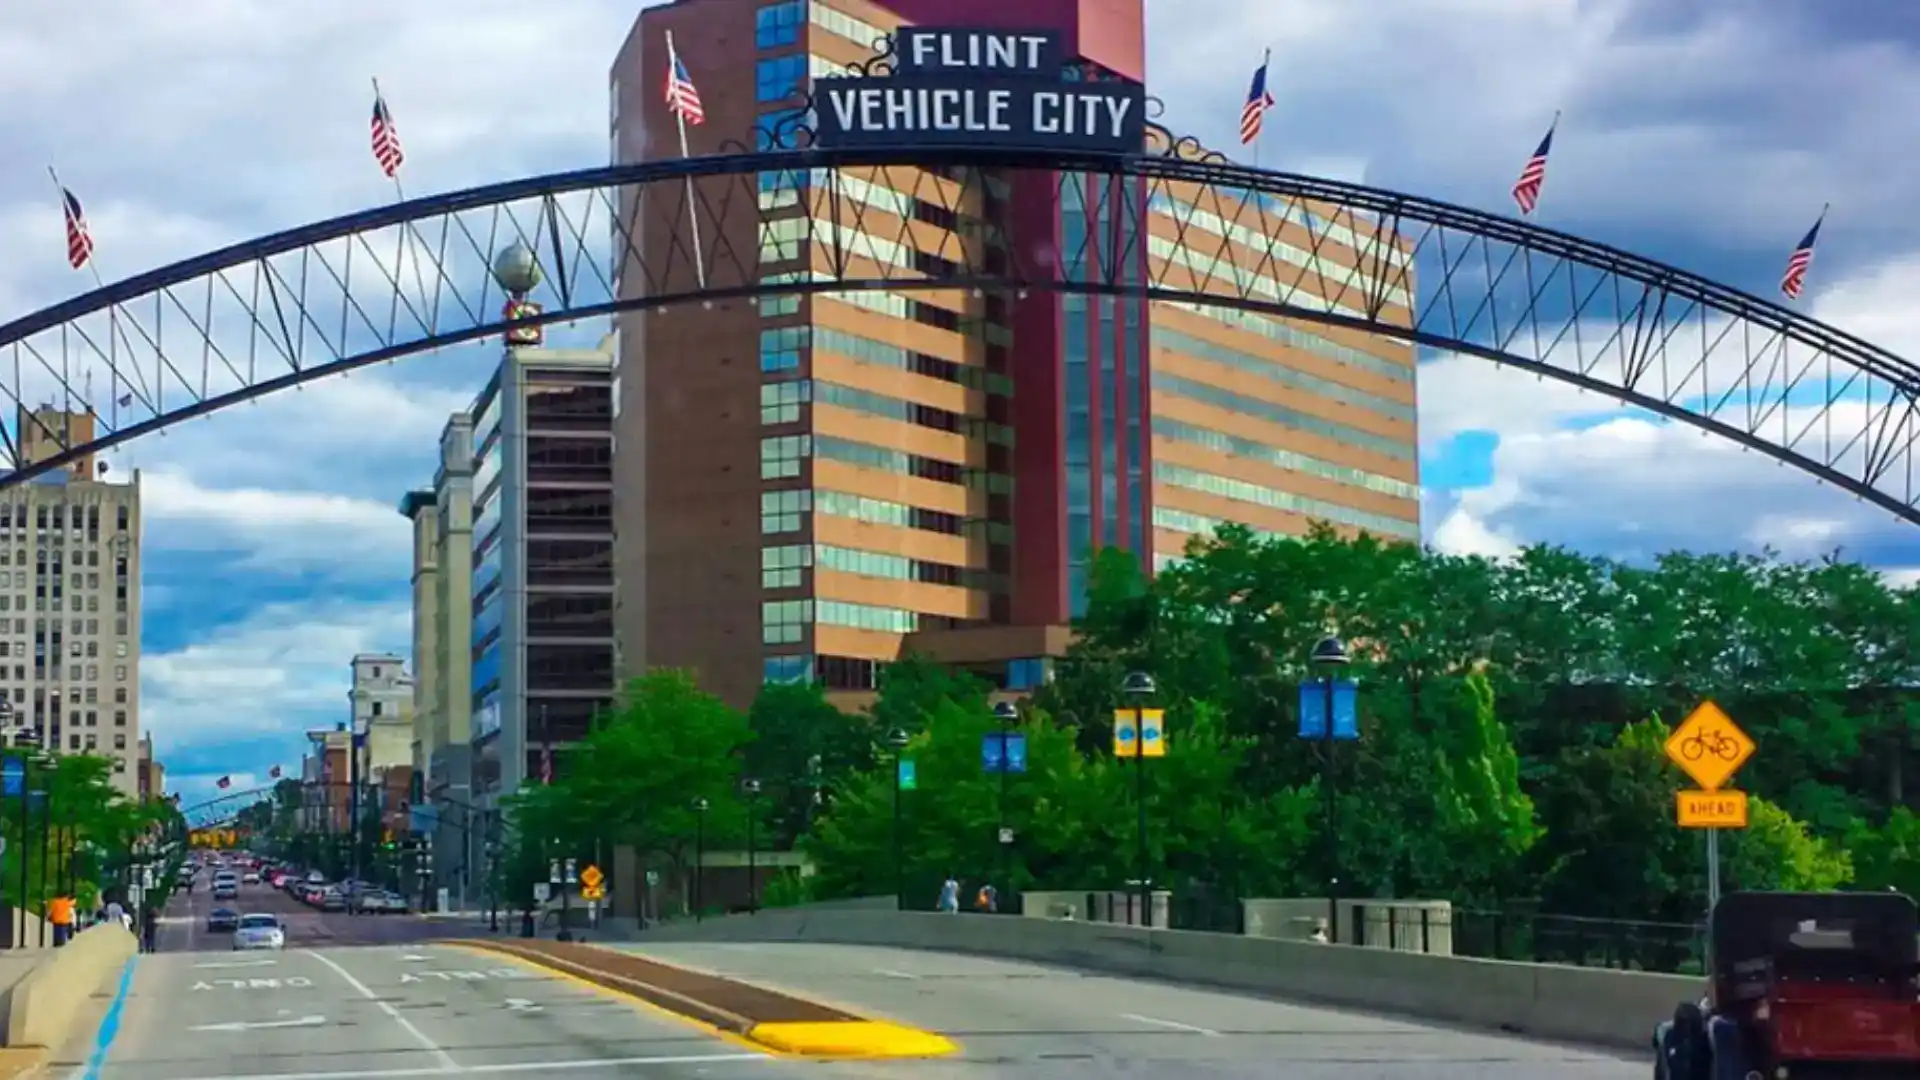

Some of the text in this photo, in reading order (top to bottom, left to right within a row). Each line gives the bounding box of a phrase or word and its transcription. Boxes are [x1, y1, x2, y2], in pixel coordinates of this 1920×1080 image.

[912, 33, 1047, 68] FLINT
[829, 89, 1131, 138] VEHICLE CITY
[1690, 802, 1736, 816] AHEAD
[193, 976, 312, 991] ONLY
